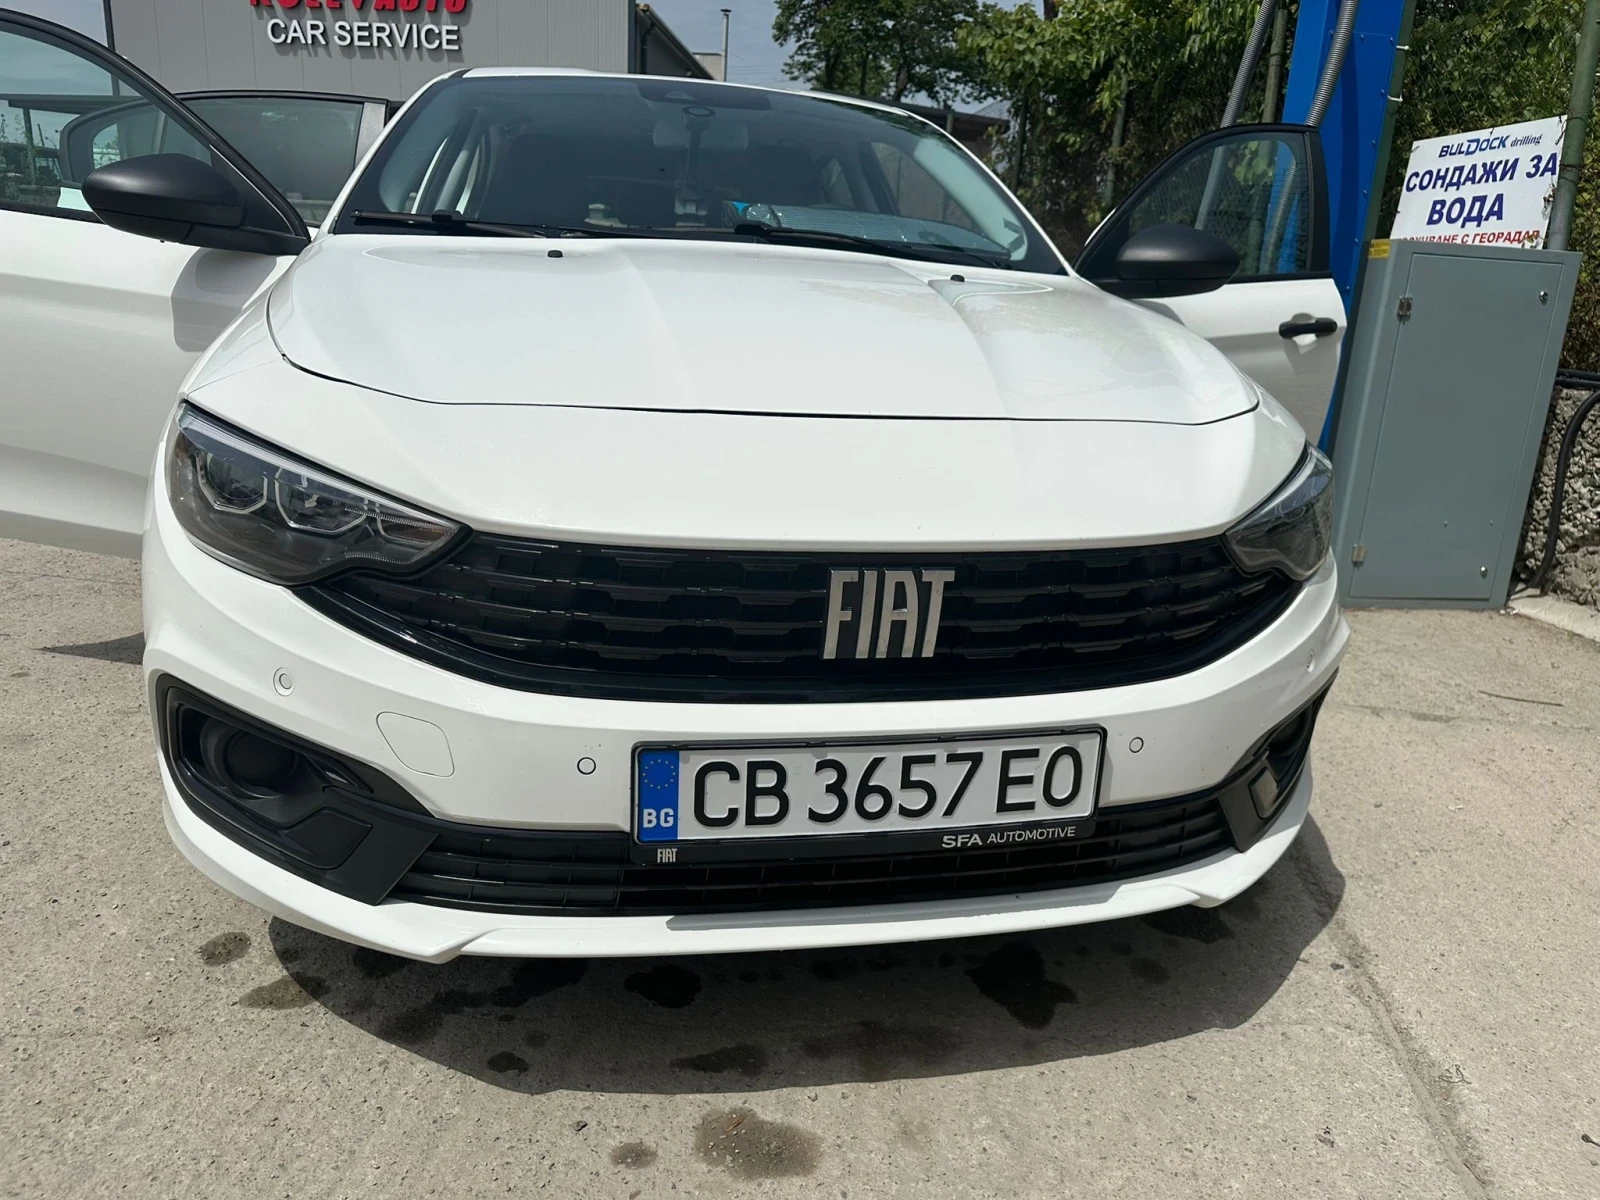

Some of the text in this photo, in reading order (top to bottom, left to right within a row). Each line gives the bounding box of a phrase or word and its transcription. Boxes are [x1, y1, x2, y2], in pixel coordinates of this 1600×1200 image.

[267, 18, 460, 50] CAR SERVICE
[1510, 134, 1543, 147] drilling
[1405, 152, 1558, 192] СОНДАЖИ ЗА
[1426, 193, 1504, 229] ВОДА
[822, 567, 956, 660] FIAT
[693, 760, 790, 827] CB
[808, 751, 984, 823] 3657
[642, 807, 675, 828] BG
[941, 826, 1076, 848] SFA AUTOMOTIVE
[656, 848, 678, 864] FIAT
